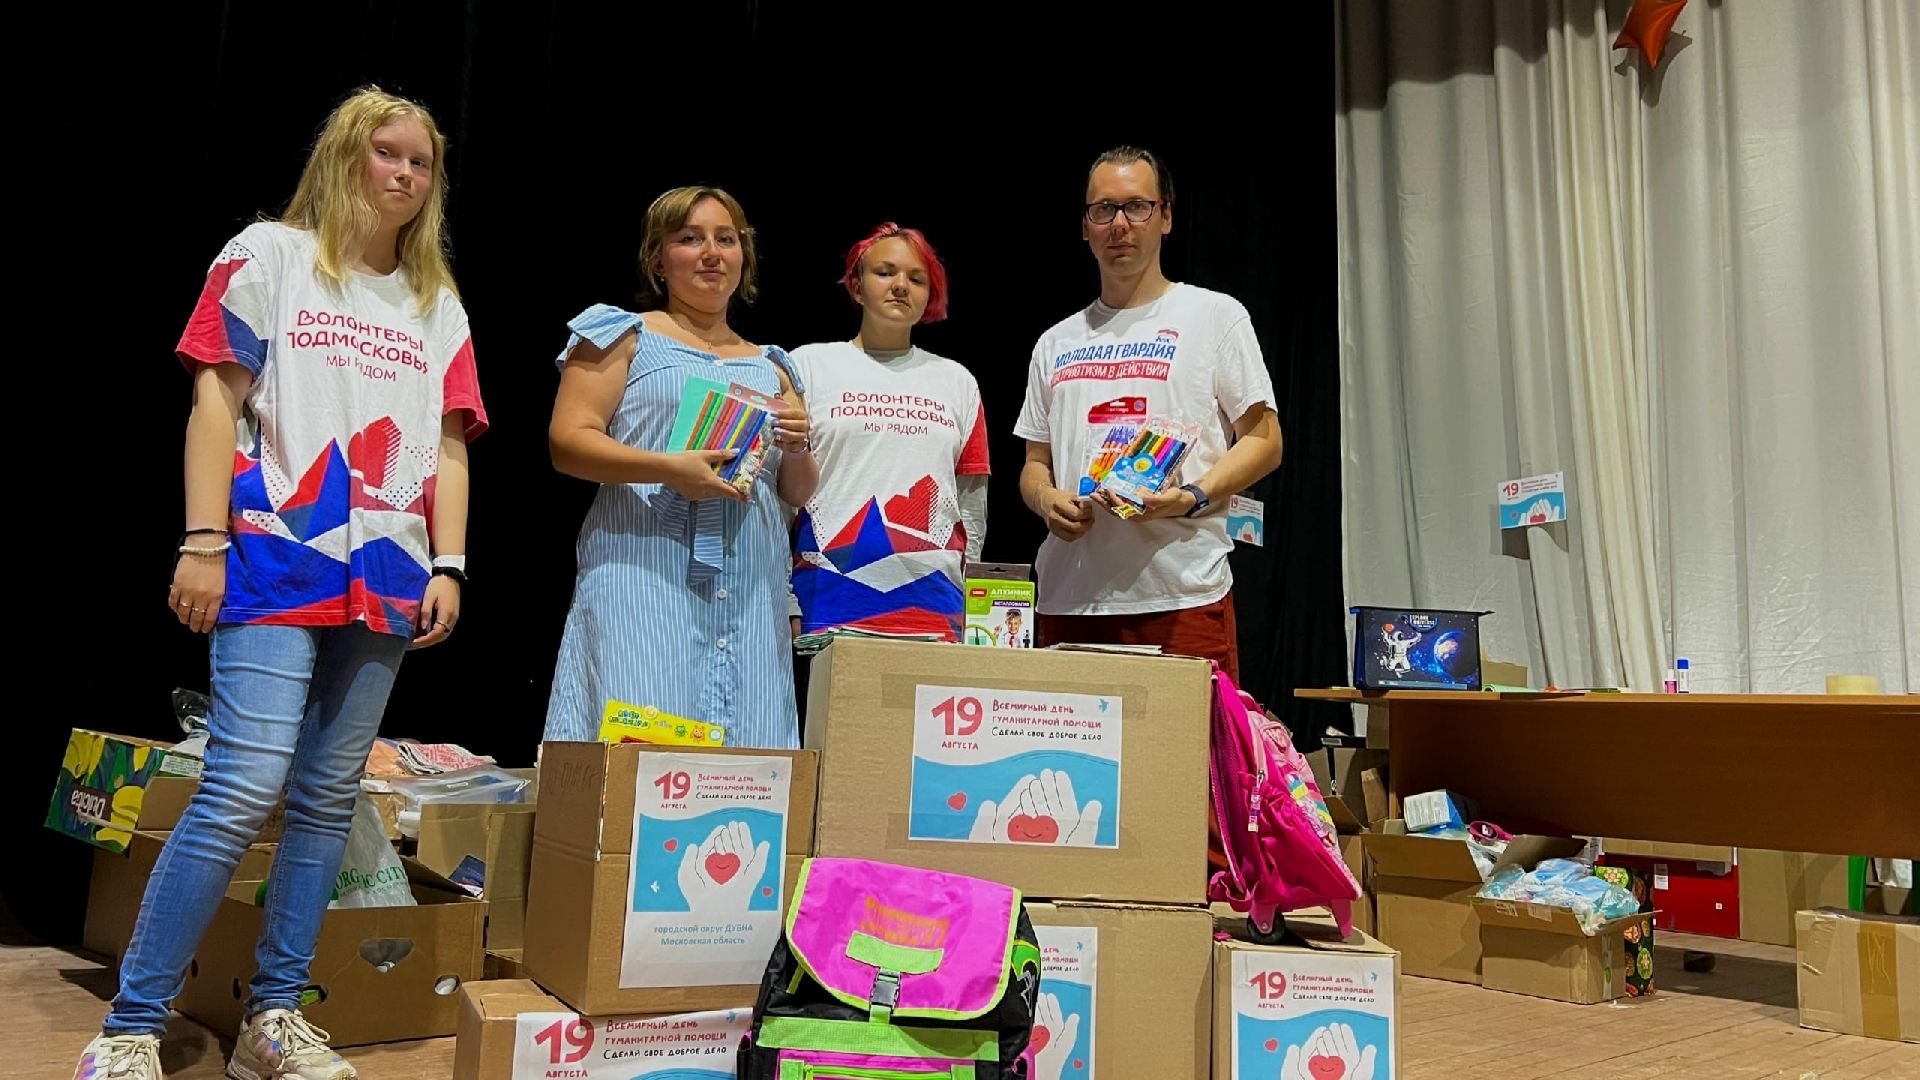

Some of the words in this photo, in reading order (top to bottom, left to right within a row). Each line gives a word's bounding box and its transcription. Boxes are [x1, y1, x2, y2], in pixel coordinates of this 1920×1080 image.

[297, 310, 424, 352] ВОЛОНТЕРЫ
[1055, 344, 1114, 369] МОЛОДАЯ
[1115, 342, 1176, 360] ГВАРДИЯ
[1052, 364, 1107, 382] ПАТРИОТИЗМ
[1108, 364, 1116, 378] В
[1116, 362, 1168, 378] ДЕЙСТВИИ
[842, 391, 946, 412] ВОЛОНТЕРЫ
[830, 405, 955, 429] ПОДМОСКОВЬЯ
[864, 422, 883, 433] МЫ
[886, 423, 928, 436] РЯДОМ
[1503, 482, 1519, 496] 19
[991, 588, 1032, 596] АЛХИМИК
[992, 698, 1047, 712] ВСЕМИРНЫЙ
[1050, 706, 1074, 714] ДЕНЬ
[931, 696, 984, 736] 19
[992, 716, 1060, 726] ГУМАНИТАРНОЙ
[1062, 720, 1102, 729] ПОМОЩИ
[991, 726, 1025, 737] СДЕЛАЙ
[1048, 731, 1078, 740] ДОБРОЕ
[941, 741, 978, 750] АВГУСТА
[654, 770, 692, 800] 19
[336, 868, 376, 889] ORGIC
[376, 866, 406, 884] CITY
[654, 924, 698, 934] городской
[700, 926, 723, 934] округ
[724, 924, 752, 934] ДУБНА
[660, 938, 712, 946] Московская
[714, 936, 745, 944] область
[1250, 970, 1287, 1000] 19
[606, 1018, 668, 1033] ВСЕМИРНЫЙ
[672, 1021, 698, 1029] ДЕНЬ
[534, 1018, 595, 1064] 19
[604, 1033, 681, 1045] ГУМАНИТАРНОЙ
[684, 1032, 727, 1042] ПОМОЩИ
[603, 1049, 640, 1060] СДЕЛАЙ
[668, 1047, 700, 1056] ДОБРОЕ
[704, 1046, 727, 1055] ДЕЛО
[546, 1070, 588, 1078] АВГУСТА
